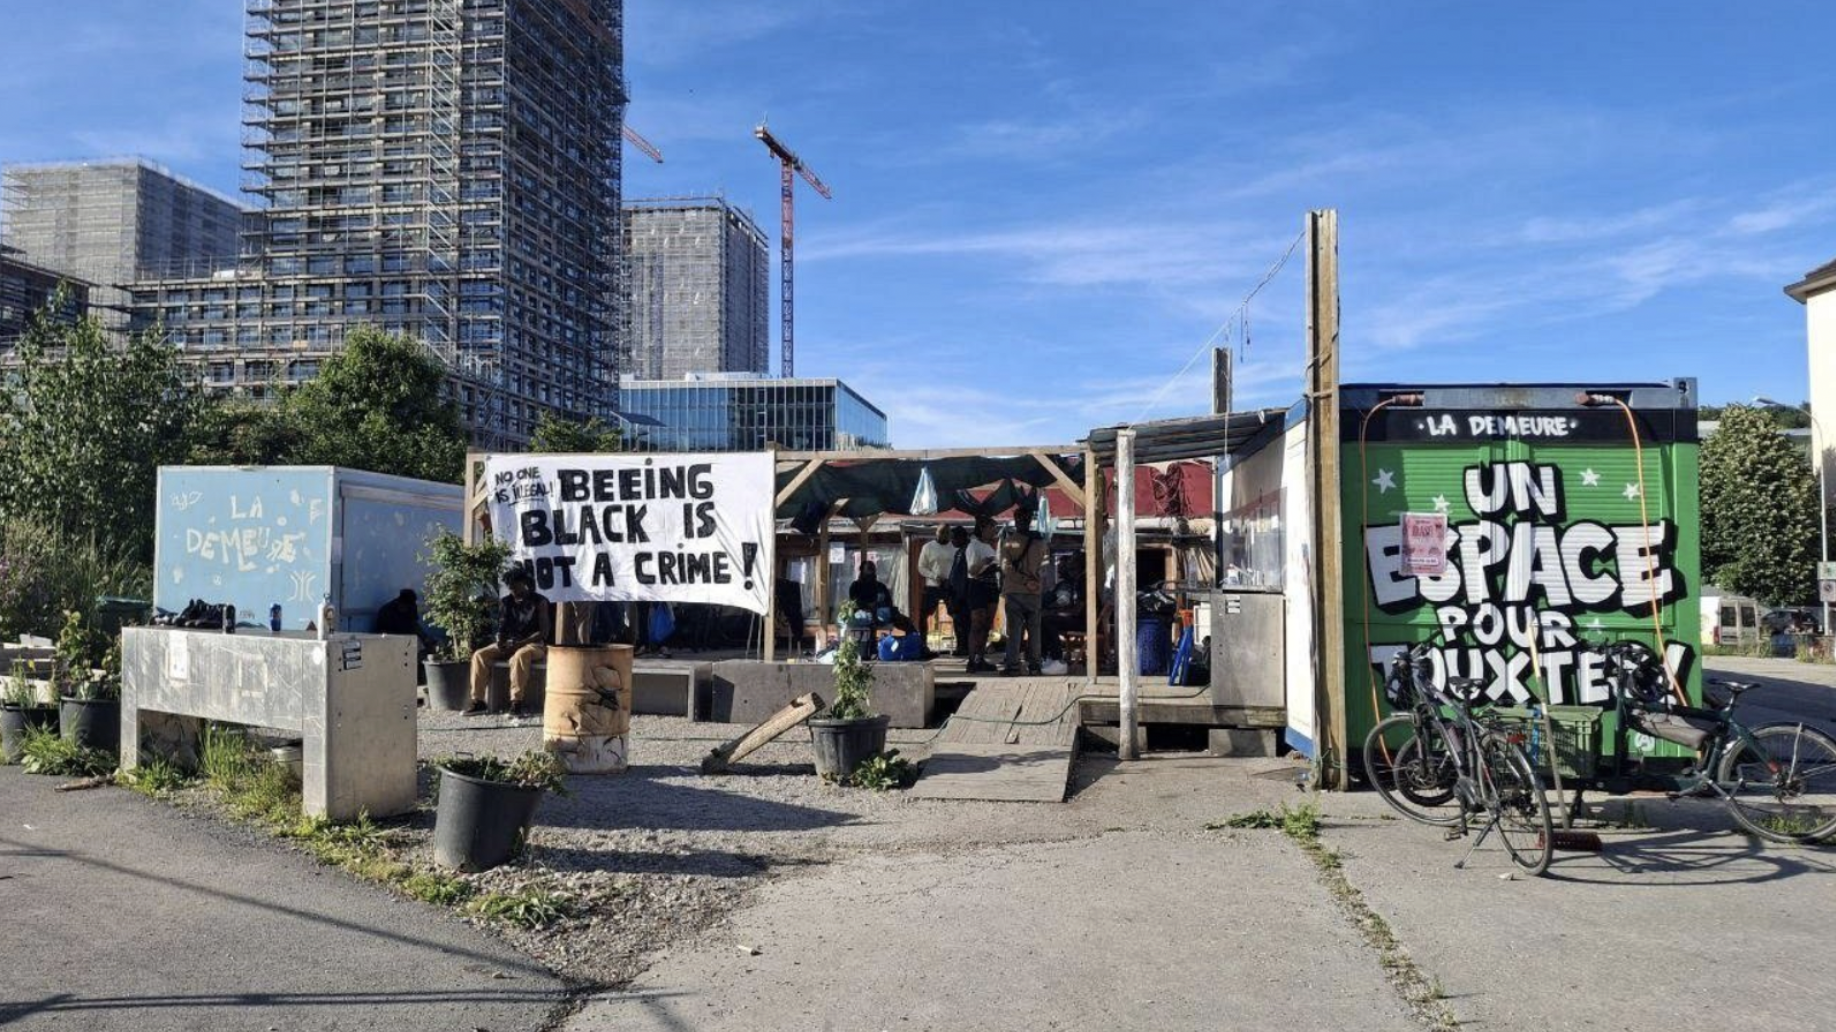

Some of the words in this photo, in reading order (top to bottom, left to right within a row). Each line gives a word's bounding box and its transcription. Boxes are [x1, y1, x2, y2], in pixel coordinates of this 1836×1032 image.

[1426, 414, 1457, 436] LA
[1468, 415, 1569, 436] DEMEURE
[495, 471, 514, 485] NO
[516, 467, 540, 480] ONE
[1464, 461, 1562, 521] UN
[230, 495, 263, 519] LA
[494, 488, 510, 503] IS
[521, 504, 650, 547] BLACK
[683, 501, 717, 539] IS
[591, 553, 614, 586] A
[1364, 520, 1680, 612] ESPACE
[1437, 604, 1578, 648] POUR
